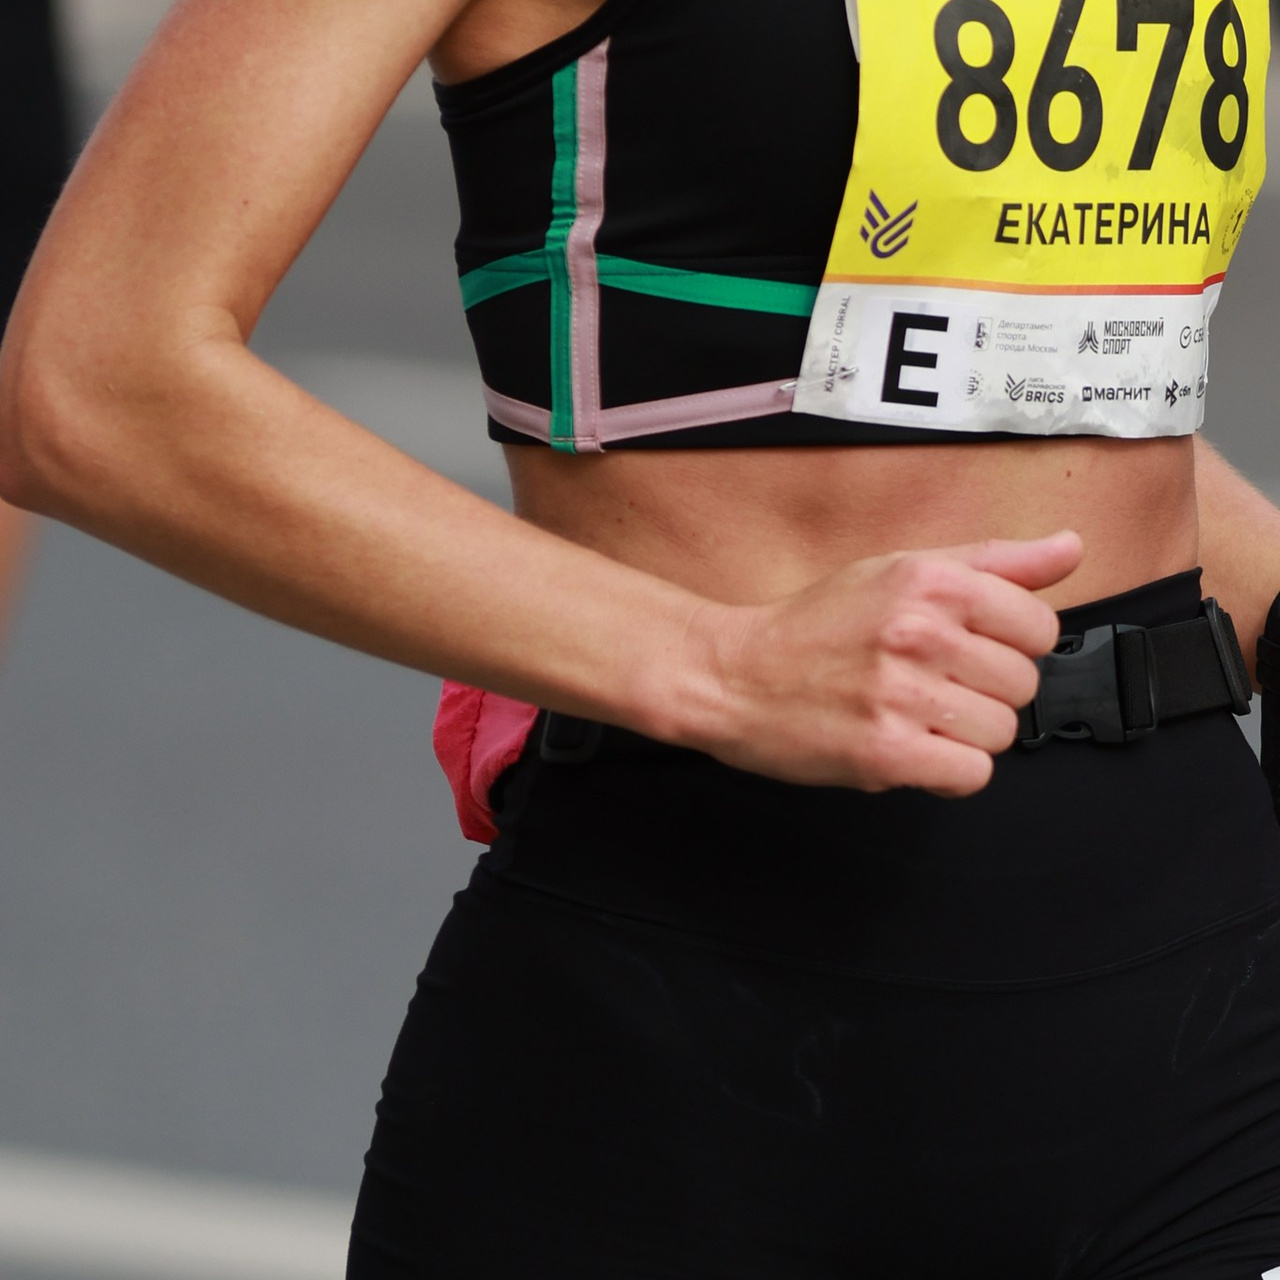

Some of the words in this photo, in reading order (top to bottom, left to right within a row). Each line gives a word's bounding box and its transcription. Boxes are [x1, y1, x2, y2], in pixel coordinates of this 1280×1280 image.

[994, 202, 1211, 245] ЕКАТЕРИНА
[834, 296, 850, 335] CORRAL
[998, 320, 1053, 331] Департамент
[1103, 316, 1165, 337] МОСКОВСКИЙ
[997, 332, 1026, 341] спорта
[995, 343, 1025, 353] города
[1027, 343, 1058, 353] Москвы
[1102, 338, 1132, 355] СПОРТ
[1025, 390, 1065, 404] BRICS
